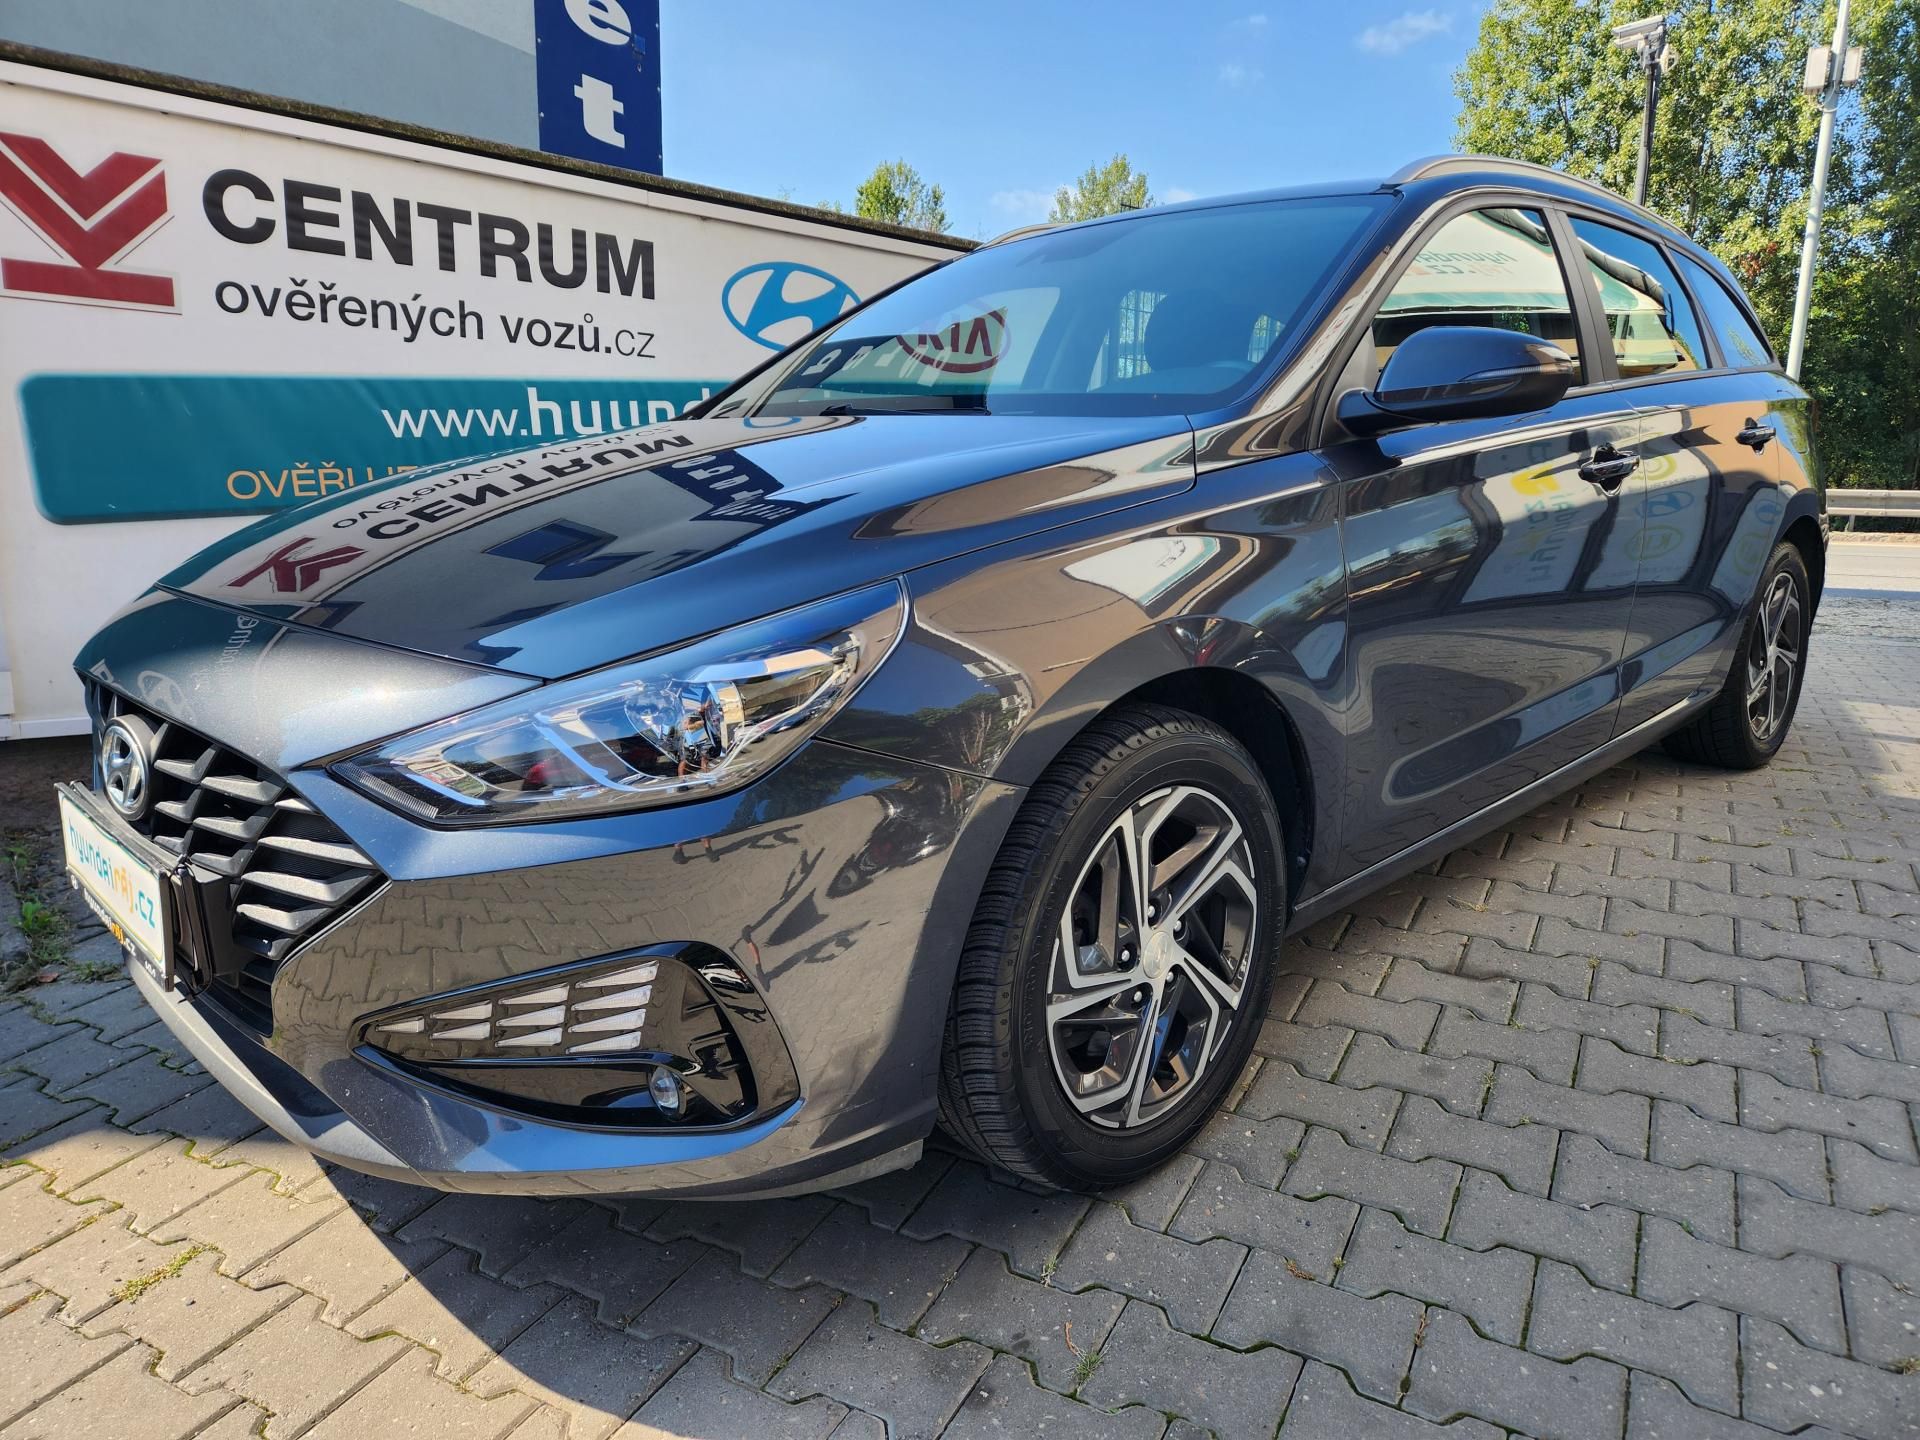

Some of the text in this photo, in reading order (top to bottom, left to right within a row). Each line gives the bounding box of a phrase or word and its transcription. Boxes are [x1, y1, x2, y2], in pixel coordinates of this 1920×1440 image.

[203, 169, 656, 300] CENTRUM
[215, 277, 657, 359] ověřených vozů.cz
